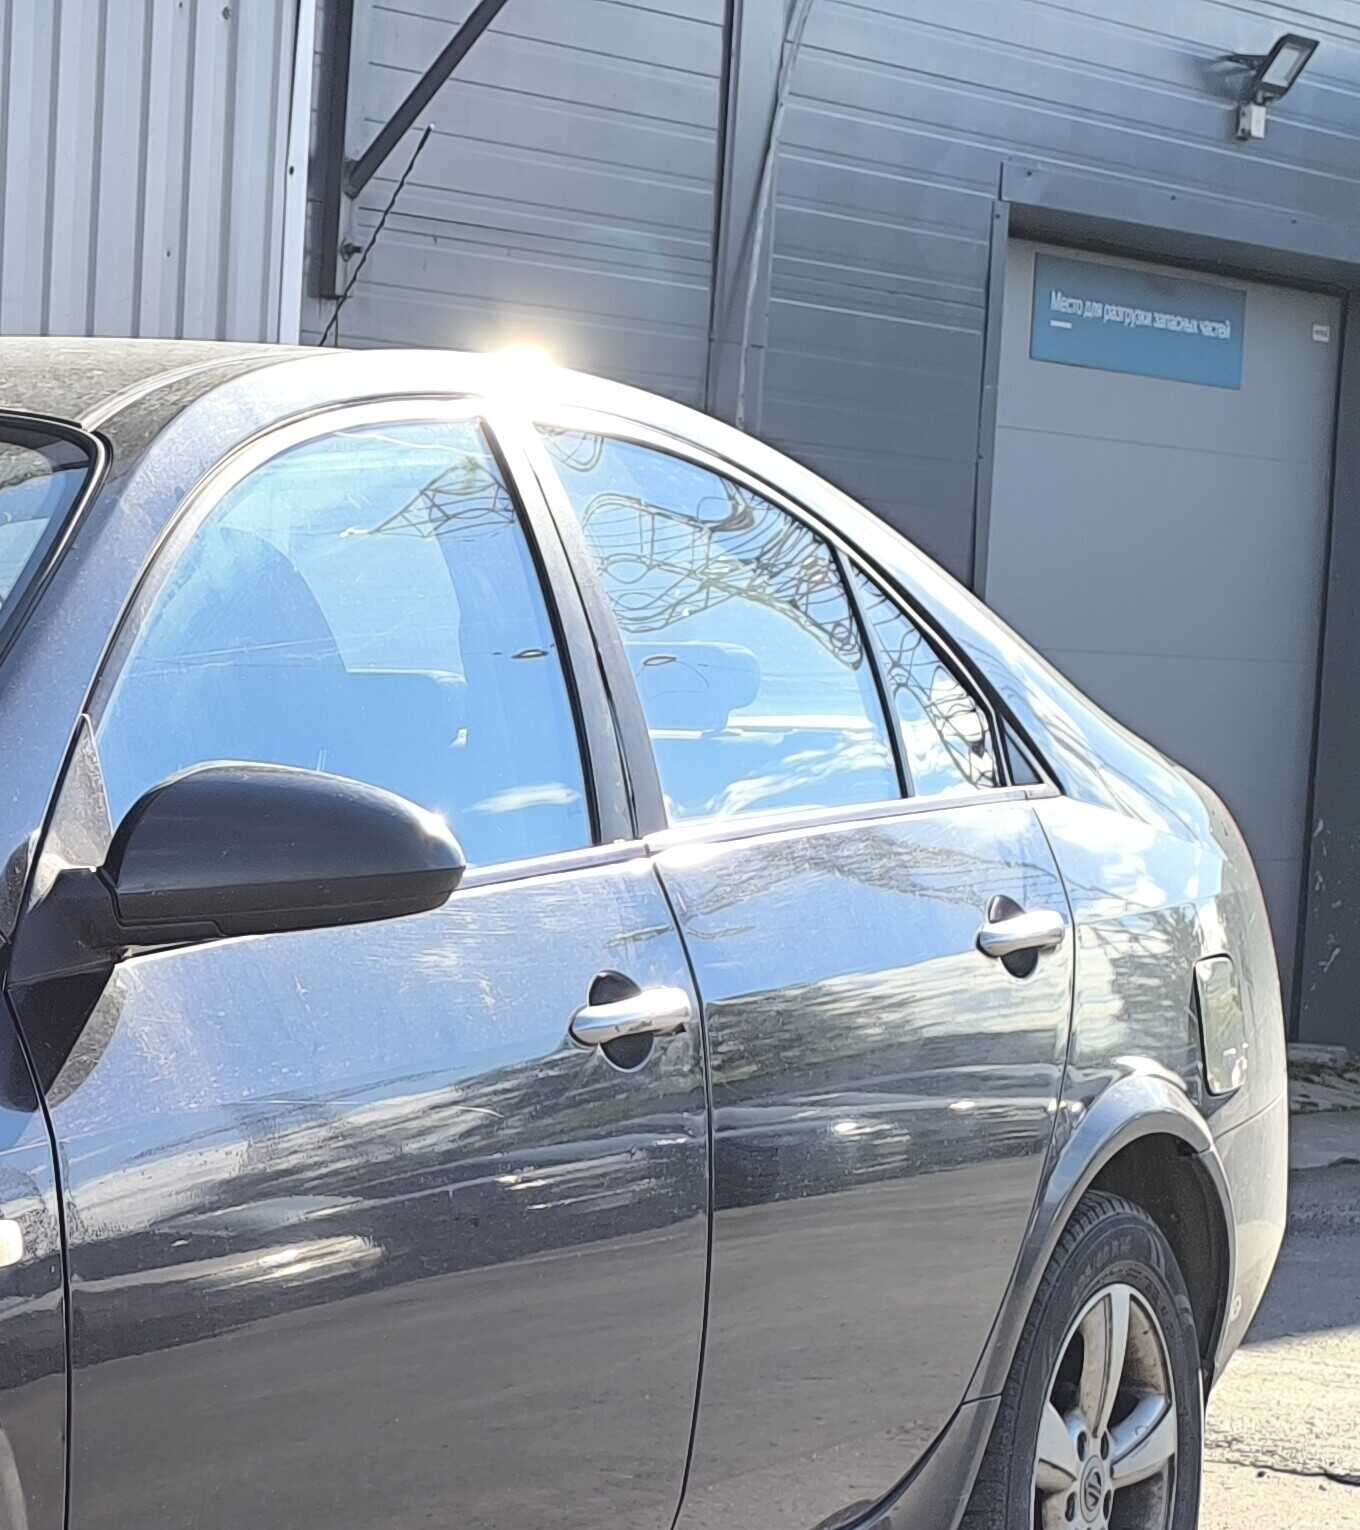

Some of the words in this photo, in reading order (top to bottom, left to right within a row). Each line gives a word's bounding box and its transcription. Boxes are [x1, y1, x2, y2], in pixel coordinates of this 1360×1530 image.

[1050, 290, 1083, 316] Место
[1083, 301, 1103, 319] для
[1103, 304, 1153, 328] разгрузки
[1153, 311, 1198, 334] запасных
[1199, 319, 1231, 340] частей
